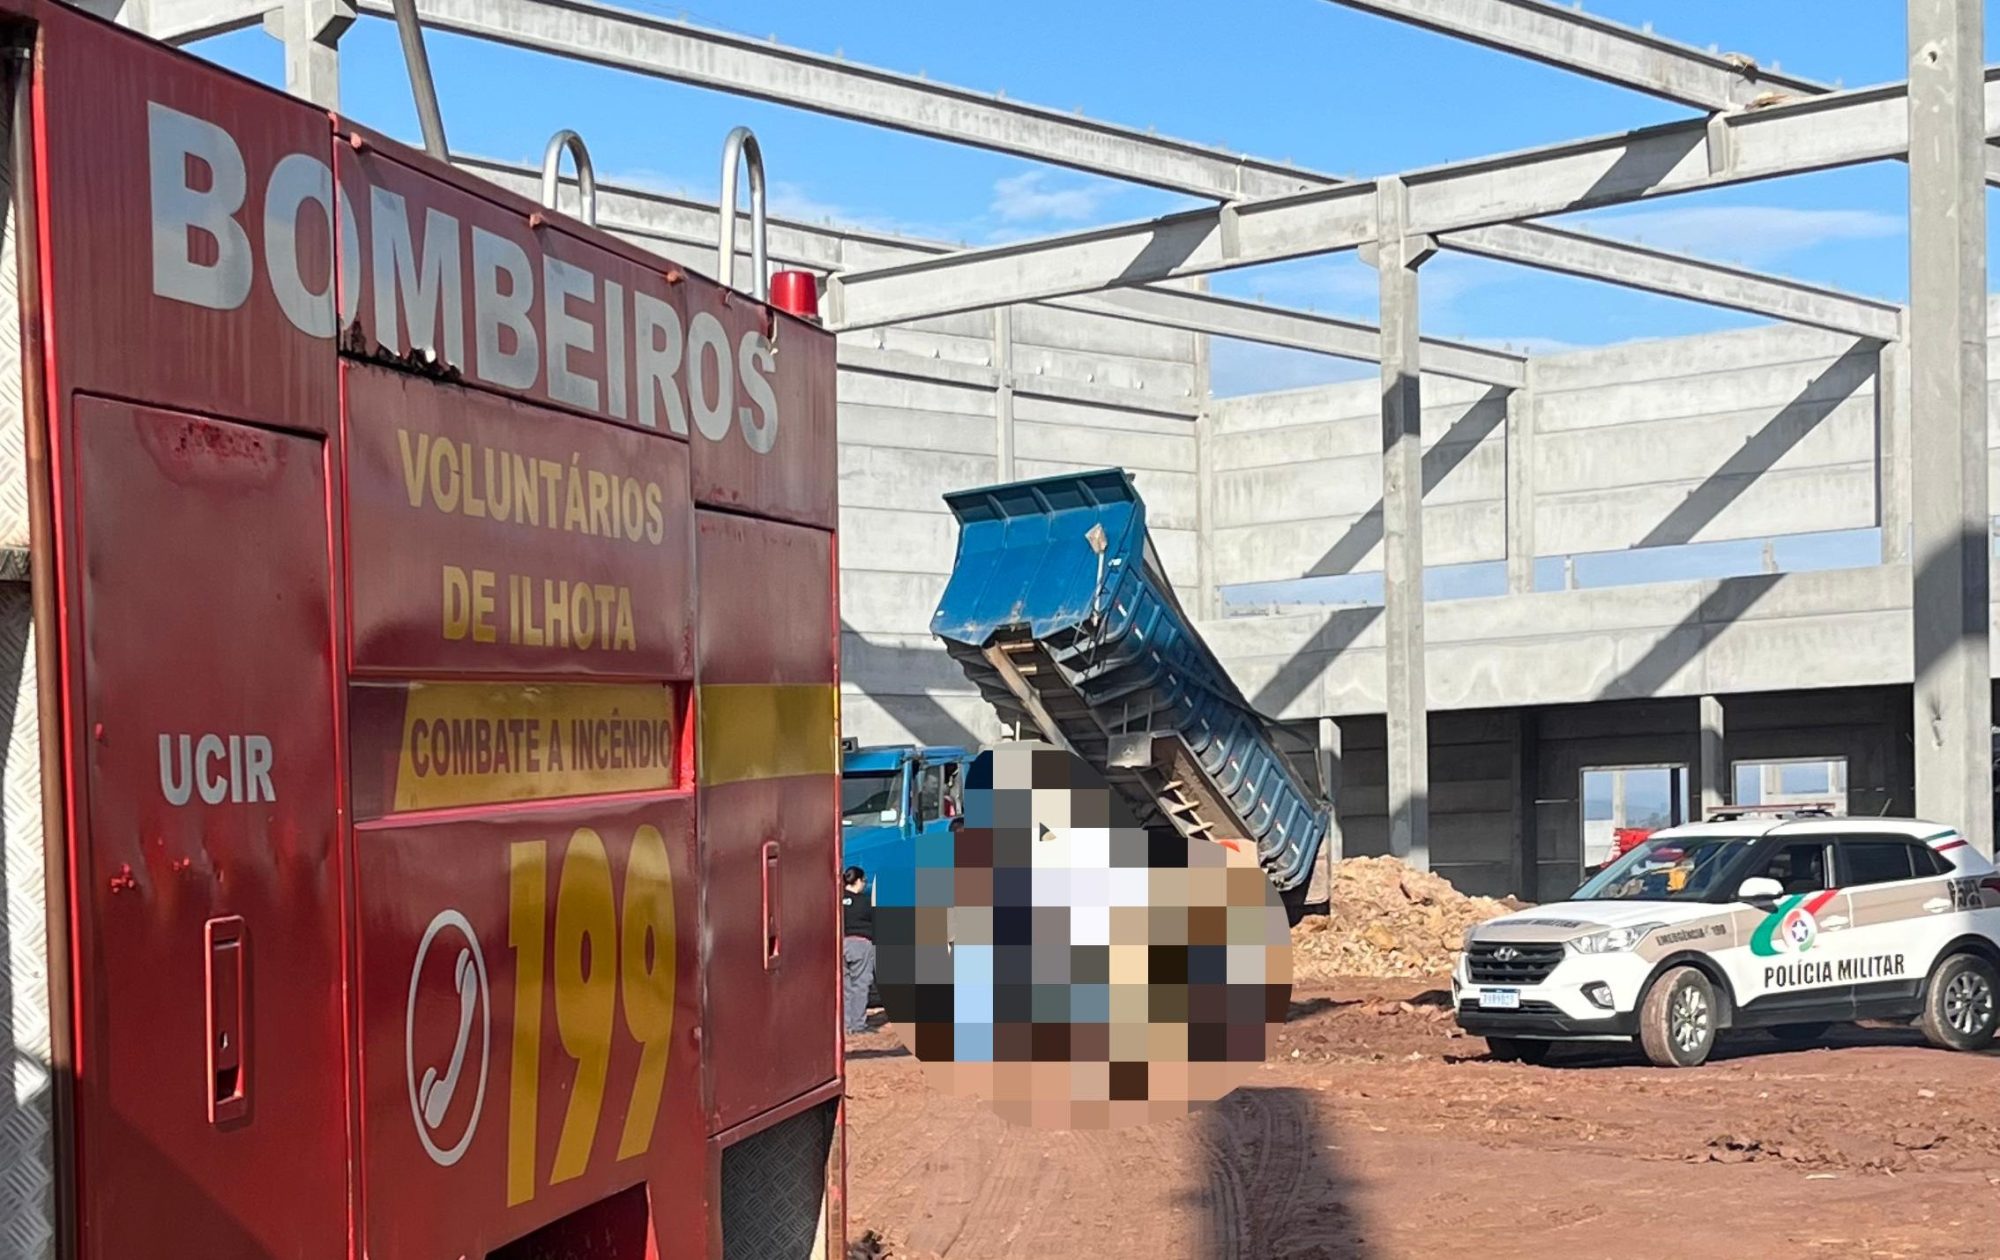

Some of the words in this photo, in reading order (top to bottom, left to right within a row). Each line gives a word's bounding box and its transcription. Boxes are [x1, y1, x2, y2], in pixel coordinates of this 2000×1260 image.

[148, 100, 777, 453] BOMBEIROS
[397, 429, 664, 545] VOLUNTÁRIOS
[443, 565, 496, 643] DE
[509, 574, 637, 651] ILHOTA
[159, 734, 275, 805] UCIR
[410, 717, 540, 777] COMBATE
[548, 719, 563, 772] A
[571, 708, 673, 770] INCÊNDIO
[1764, 959, 1833, 988] POLÍCIA
[1838, 954, 1905, 981] MILITAR
[507, 825, 677, 1207] 199
